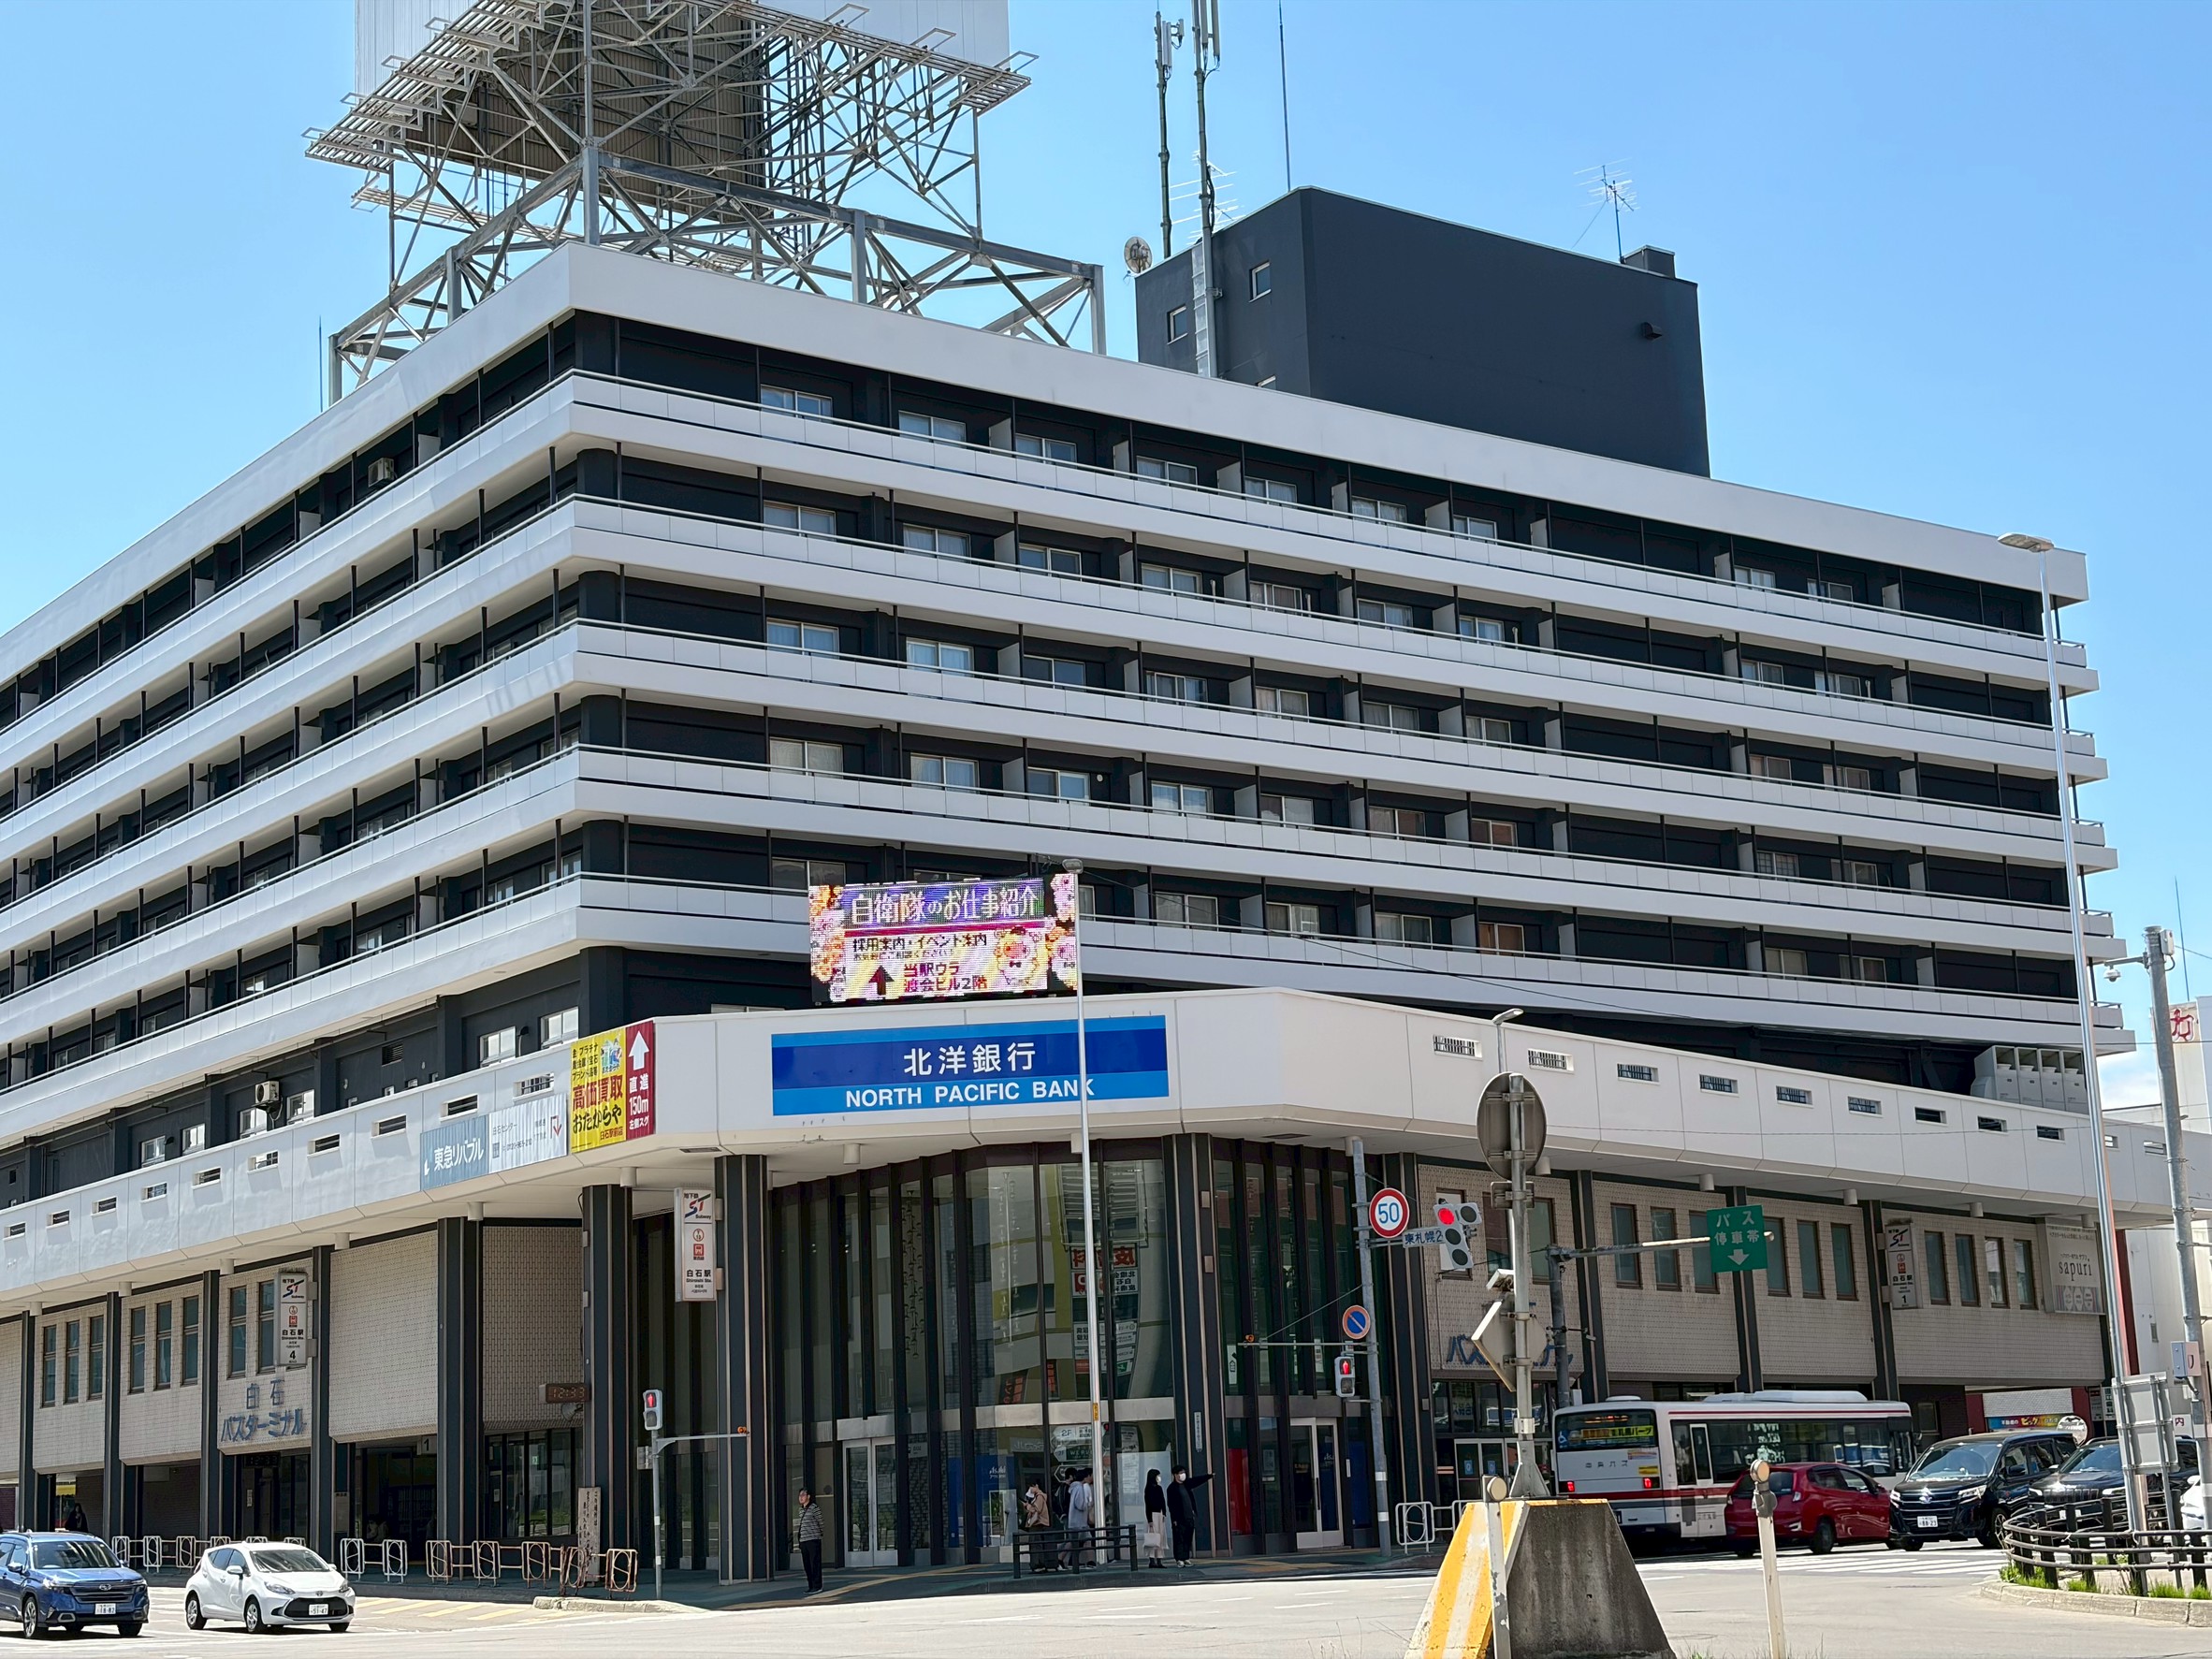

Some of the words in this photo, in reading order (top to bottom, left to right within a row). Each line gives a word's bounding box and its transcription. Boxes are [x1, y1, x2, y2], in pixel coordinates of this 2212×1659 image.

[851, 885, 1040, 924] 自衛隊のお仕事紹介
[903, 961, 960, 977] 当駅ウラ
[903, 1041, 1037, 1077] 北洋銀行
[572, 1074, 623, 1112] 高価買取
[629, 1072, 649, 1094] 直進
[845, 1086, 923, 1108] NORTH
[934, 1082, 1020, 1104] PACIFIC
[1032, 1078, 1095, 1099] BANK
[629, 1096, 649, 1116] 150m
[572, 1103, 622, 1134] おたからや
[433, 1137, 485, 1171] 東急リバブル
[1377, 1202, 1400, 1224] 50
[1716, 1211, 1754, 1228] バス
[1714, 1230, 1760, 1245] 停車帯
[686, 1269, 711, 1277] 白石駅
[2059, 1258, 2092, 1282] sapuri
[289, 1350, 296, 1360] 4
[246, 1377, 285, 1410] 白石
[551, 1387, 586, 1398] 12:33
[220, 1406, 308, 1442] バスターミナル
[424, 1438, 430, 1451] 1
